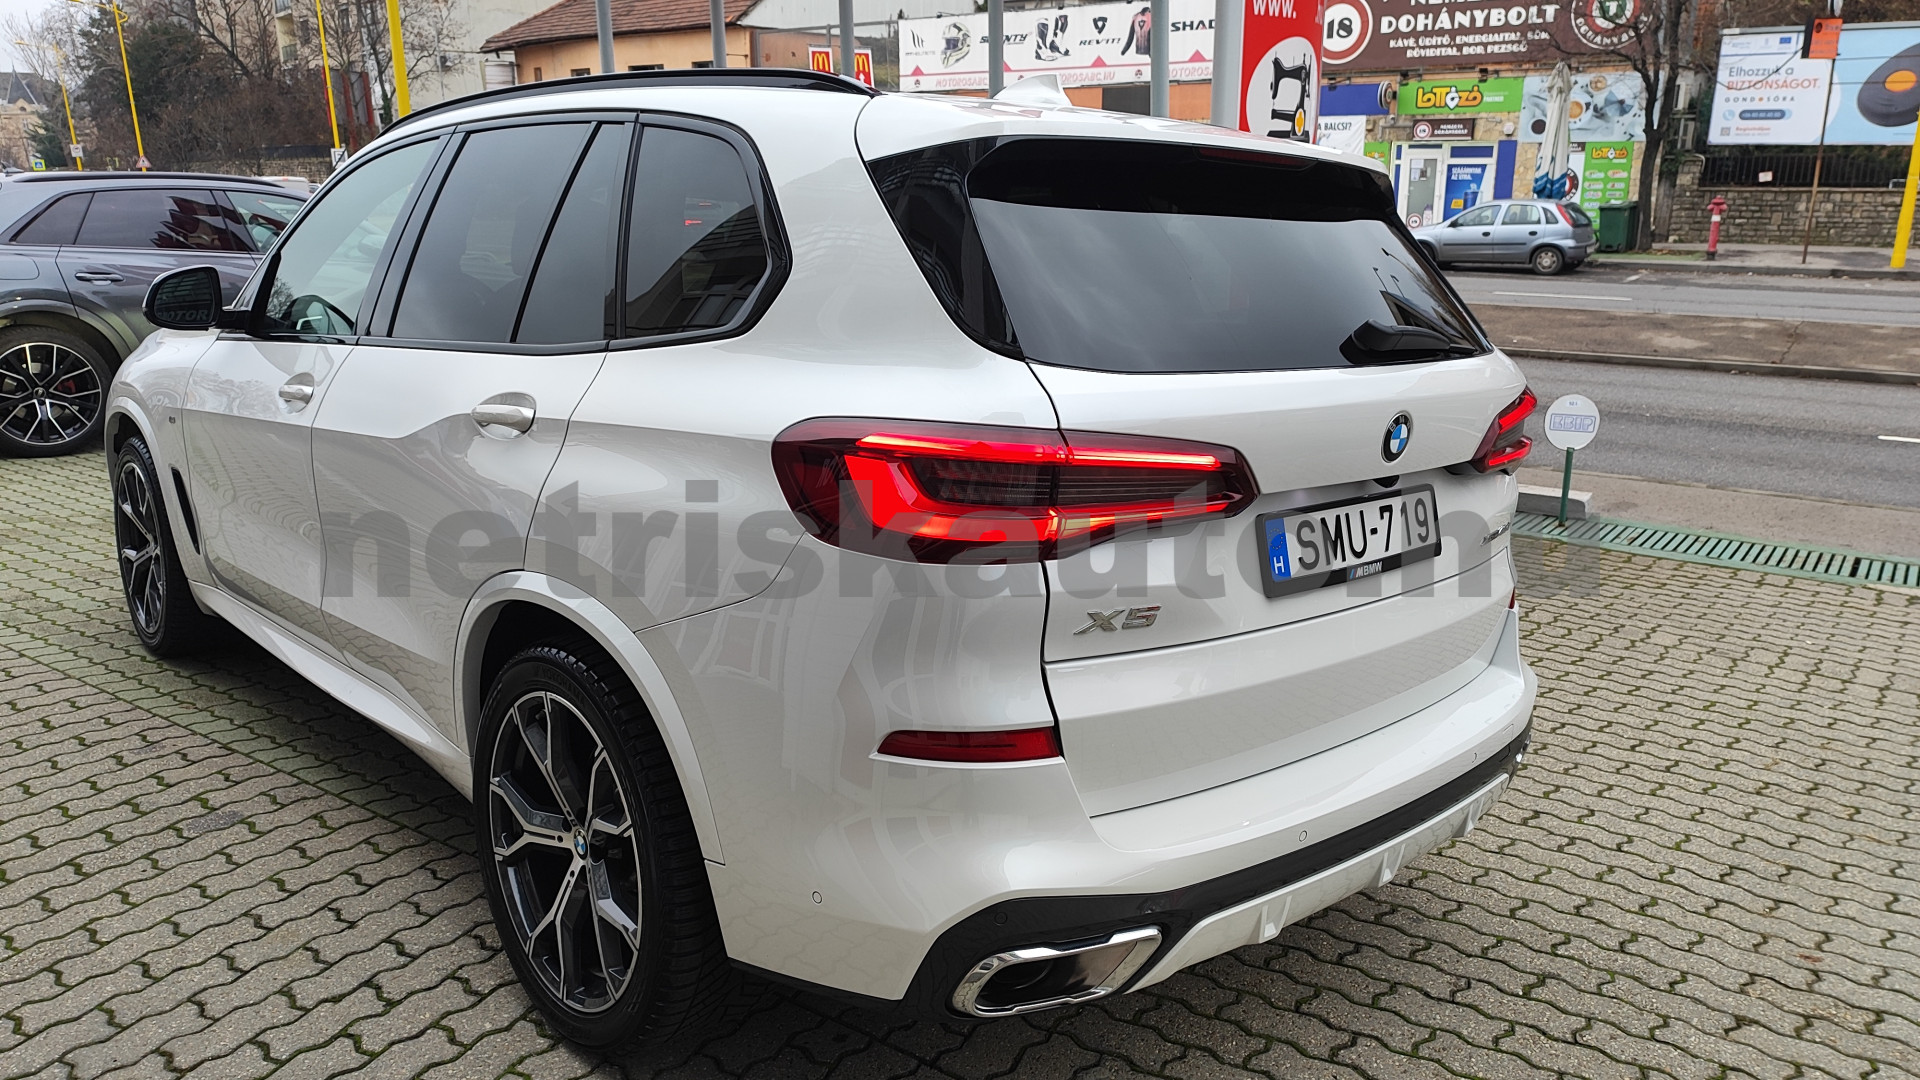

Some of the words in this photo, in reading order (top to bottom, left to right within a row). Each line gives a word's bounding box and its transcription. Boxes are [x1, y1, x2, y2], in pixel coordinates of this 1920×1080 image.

[1327, 17, 1353, 39] 18
[1380, 5, 1561, 34] DOHÁNYBOLT
[1728, 65, 1781, 78] Elhozzuk
[1785, 67, 1794, 75] a
[1727, 77, 1820, 91] BIZTONSÁGOT.
[1296, 497, 1430, 570] SMU-719
[1273, 555, 1285, 574] H
[1073, 605, 1162, 635] X5
